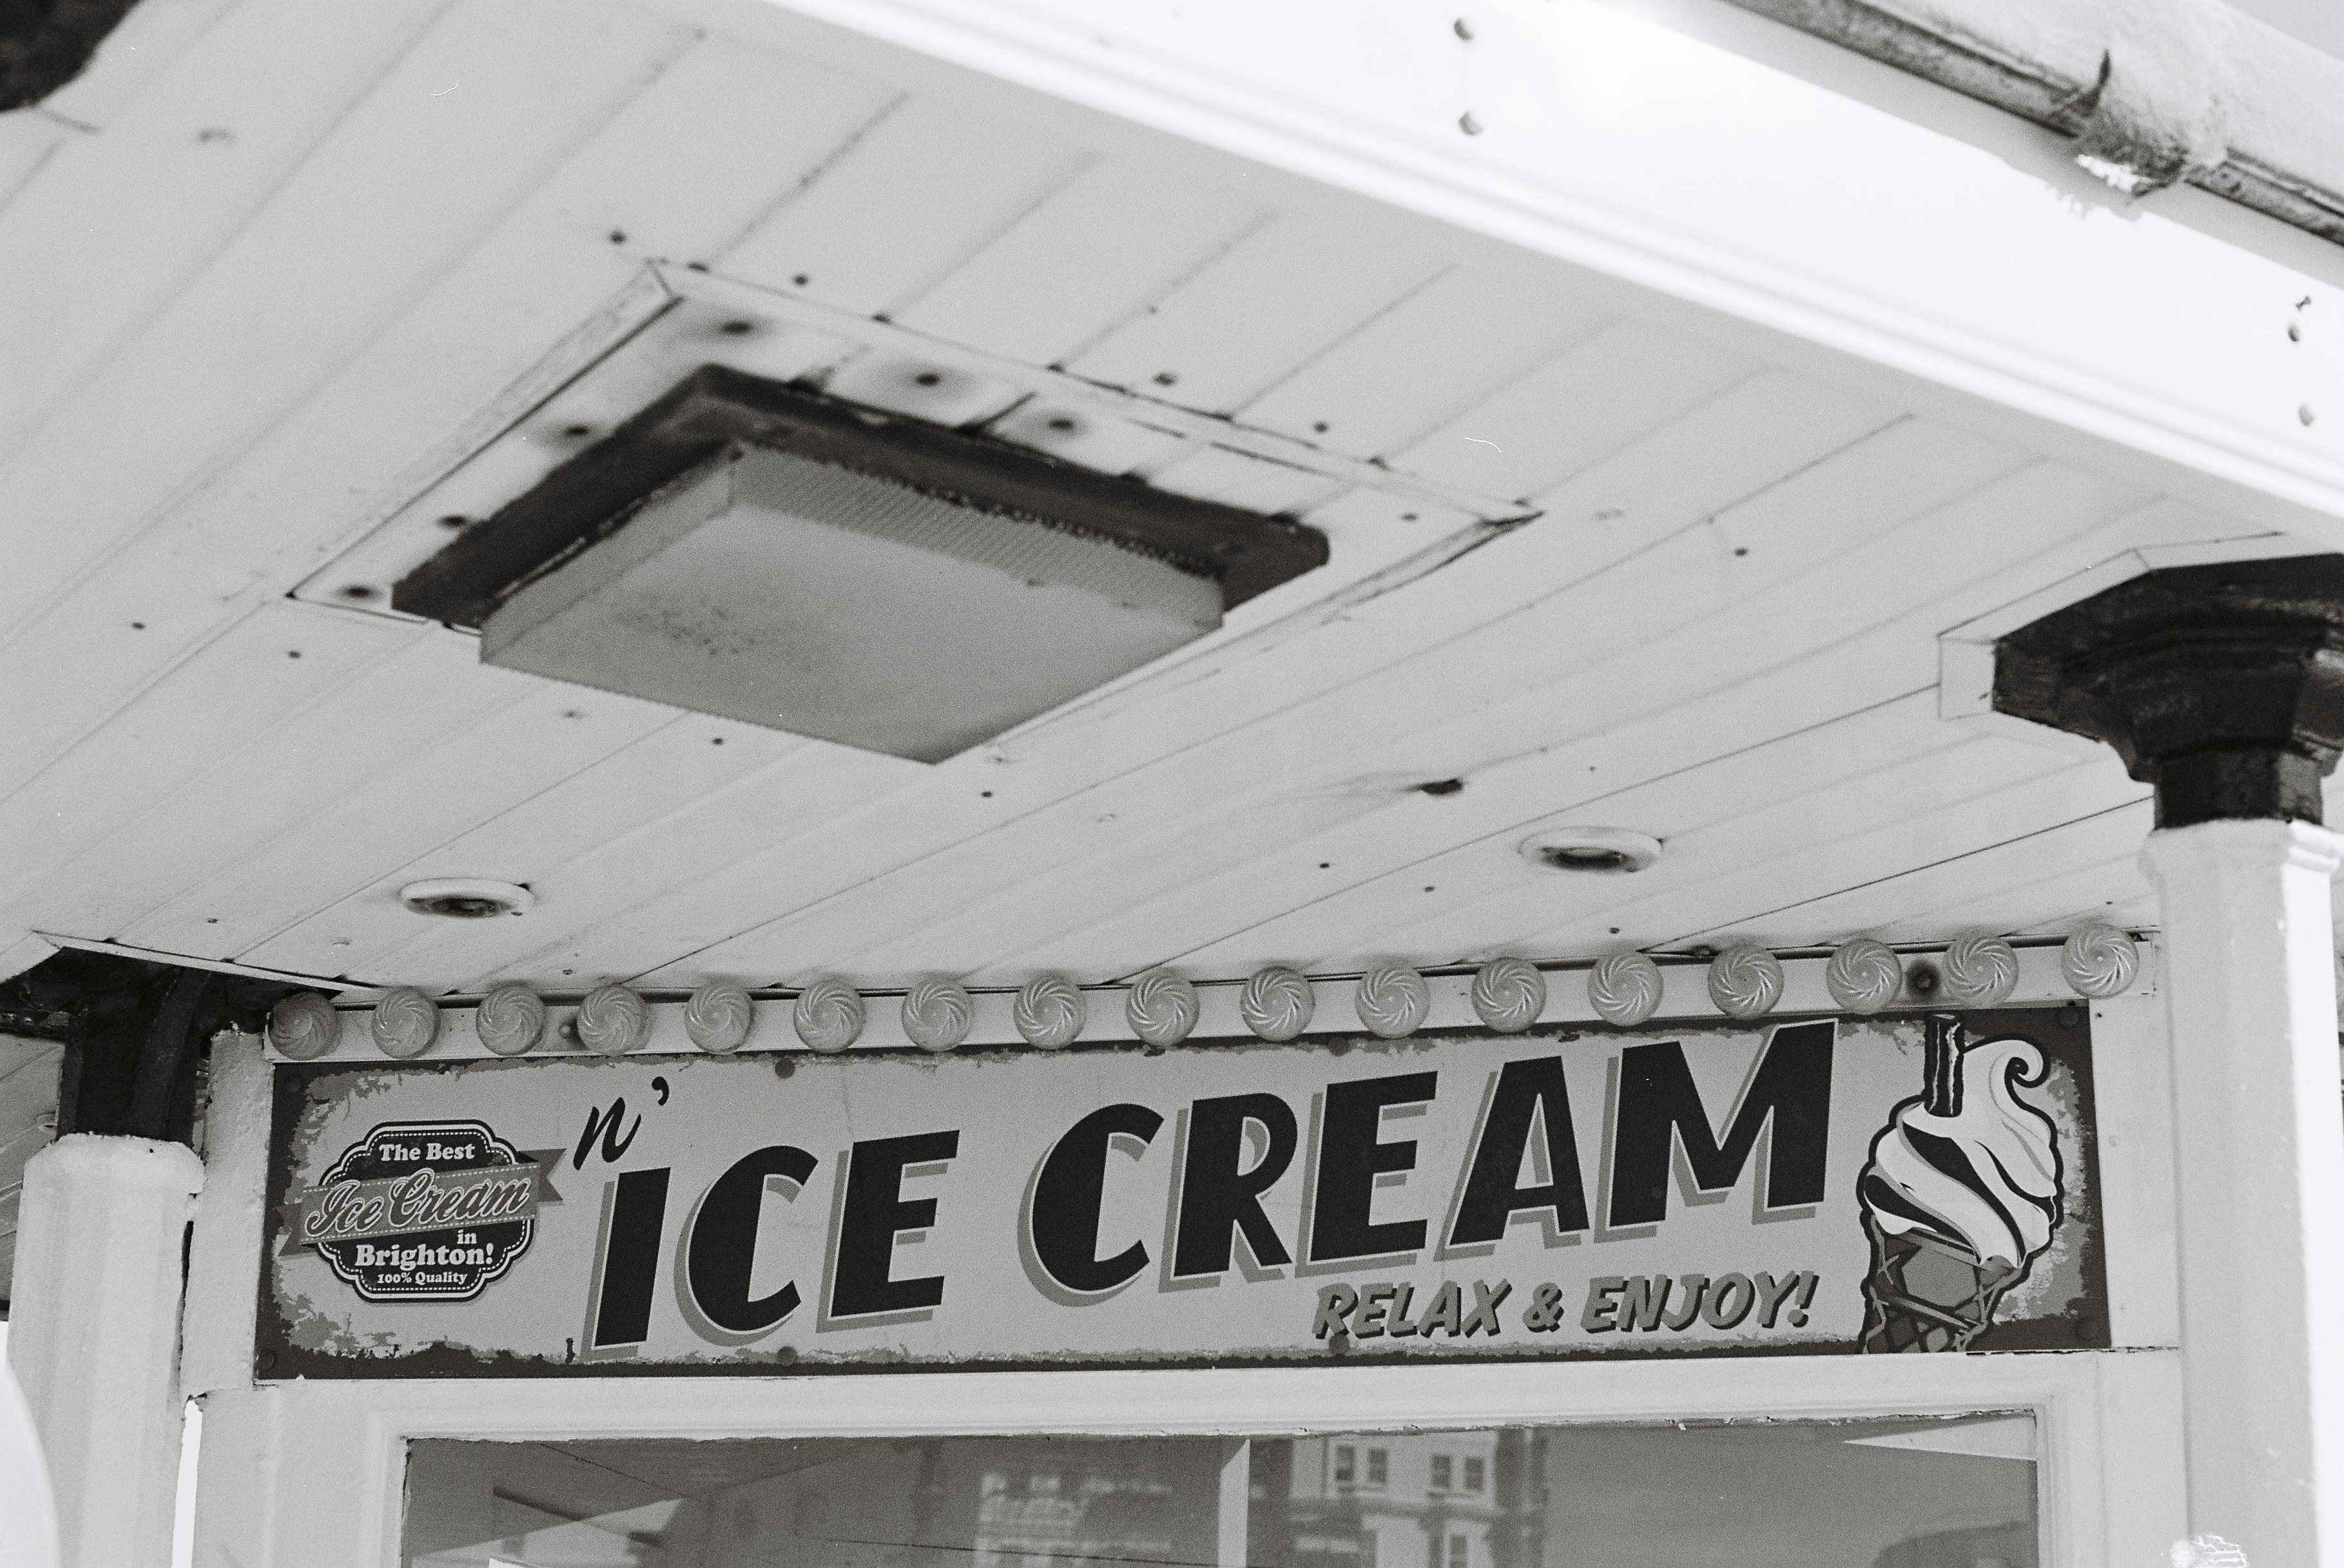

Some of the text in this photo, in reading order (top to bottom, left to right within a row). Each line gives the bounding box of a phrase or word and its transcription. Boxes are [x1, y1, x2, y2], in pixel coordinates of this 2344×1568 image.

[379, 1143, 476, 1161] The Best
[581, 1018, 1837, 1356] ICE CREAM
[305, 1168, 532, 1237] Ice Cream
[457, 1229, 477, 1245] in
[355, 1243, 494, 1270] Brighton!
[377, 1272, 467, 1286] 100% Quality
[1312, 1270, 1820, 1339] RELAX & ENJOY!
